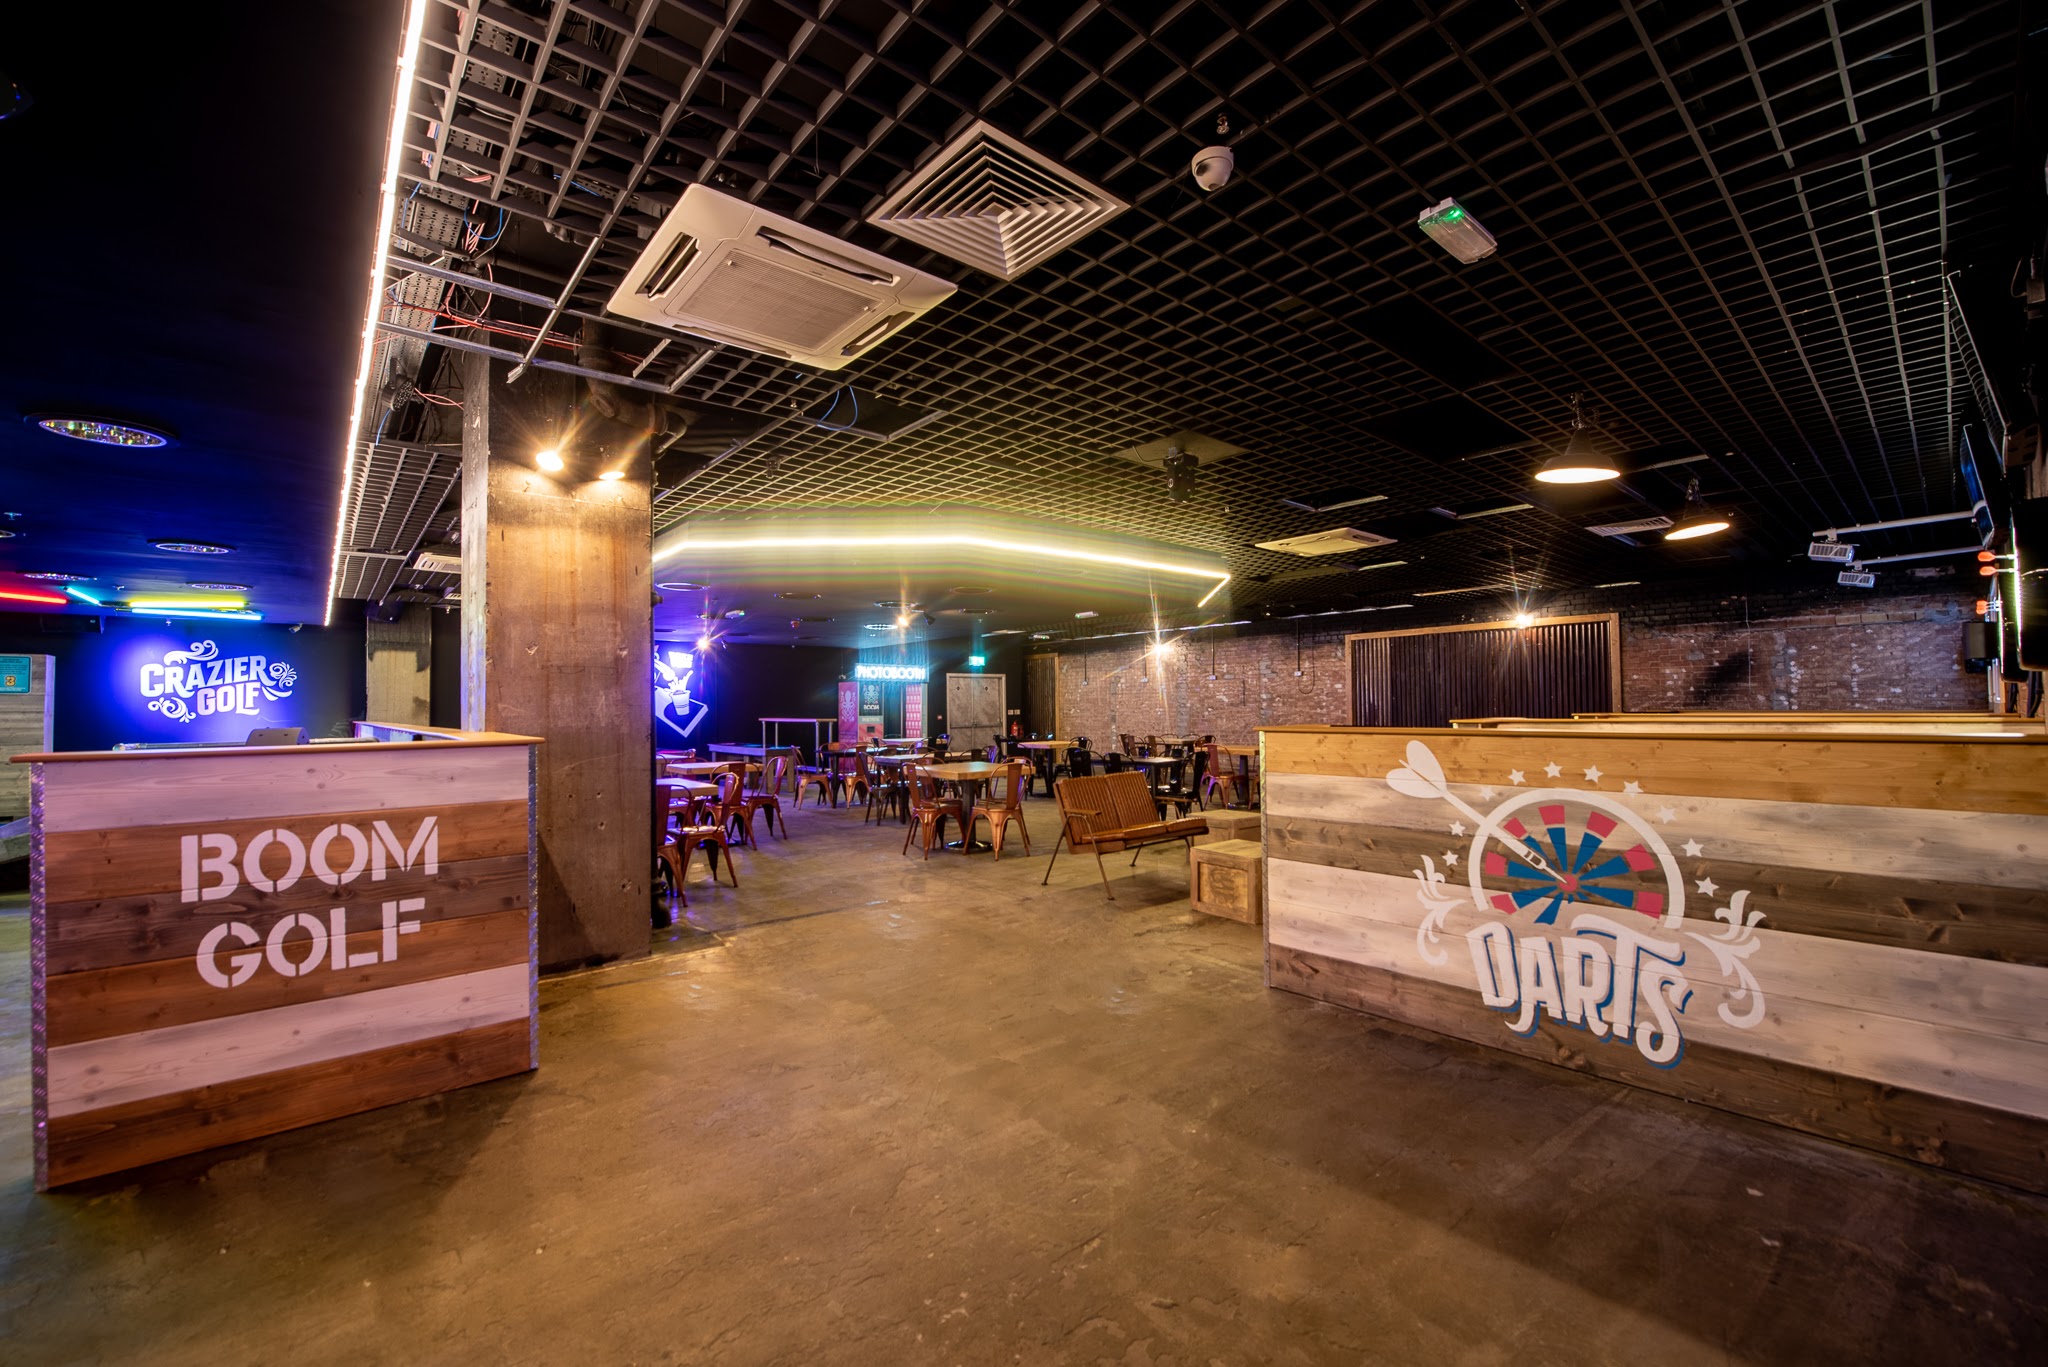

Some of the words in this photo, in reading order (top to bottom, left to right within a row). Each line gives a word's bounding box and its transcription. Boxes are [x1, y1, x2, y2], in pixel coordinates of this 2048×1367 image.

[5, 675, 16, 687] 3
[140, 655, 277, 698] CRAZIER
[856, 665, 926, 680] PHOTOBOOTH
[197, 681, 261, 716] GOLF
[180, 816, 439, 903] BOOM
[196, 897, 426, 989] GOLF
[1465, 914, 1694, 1070] DARTS
